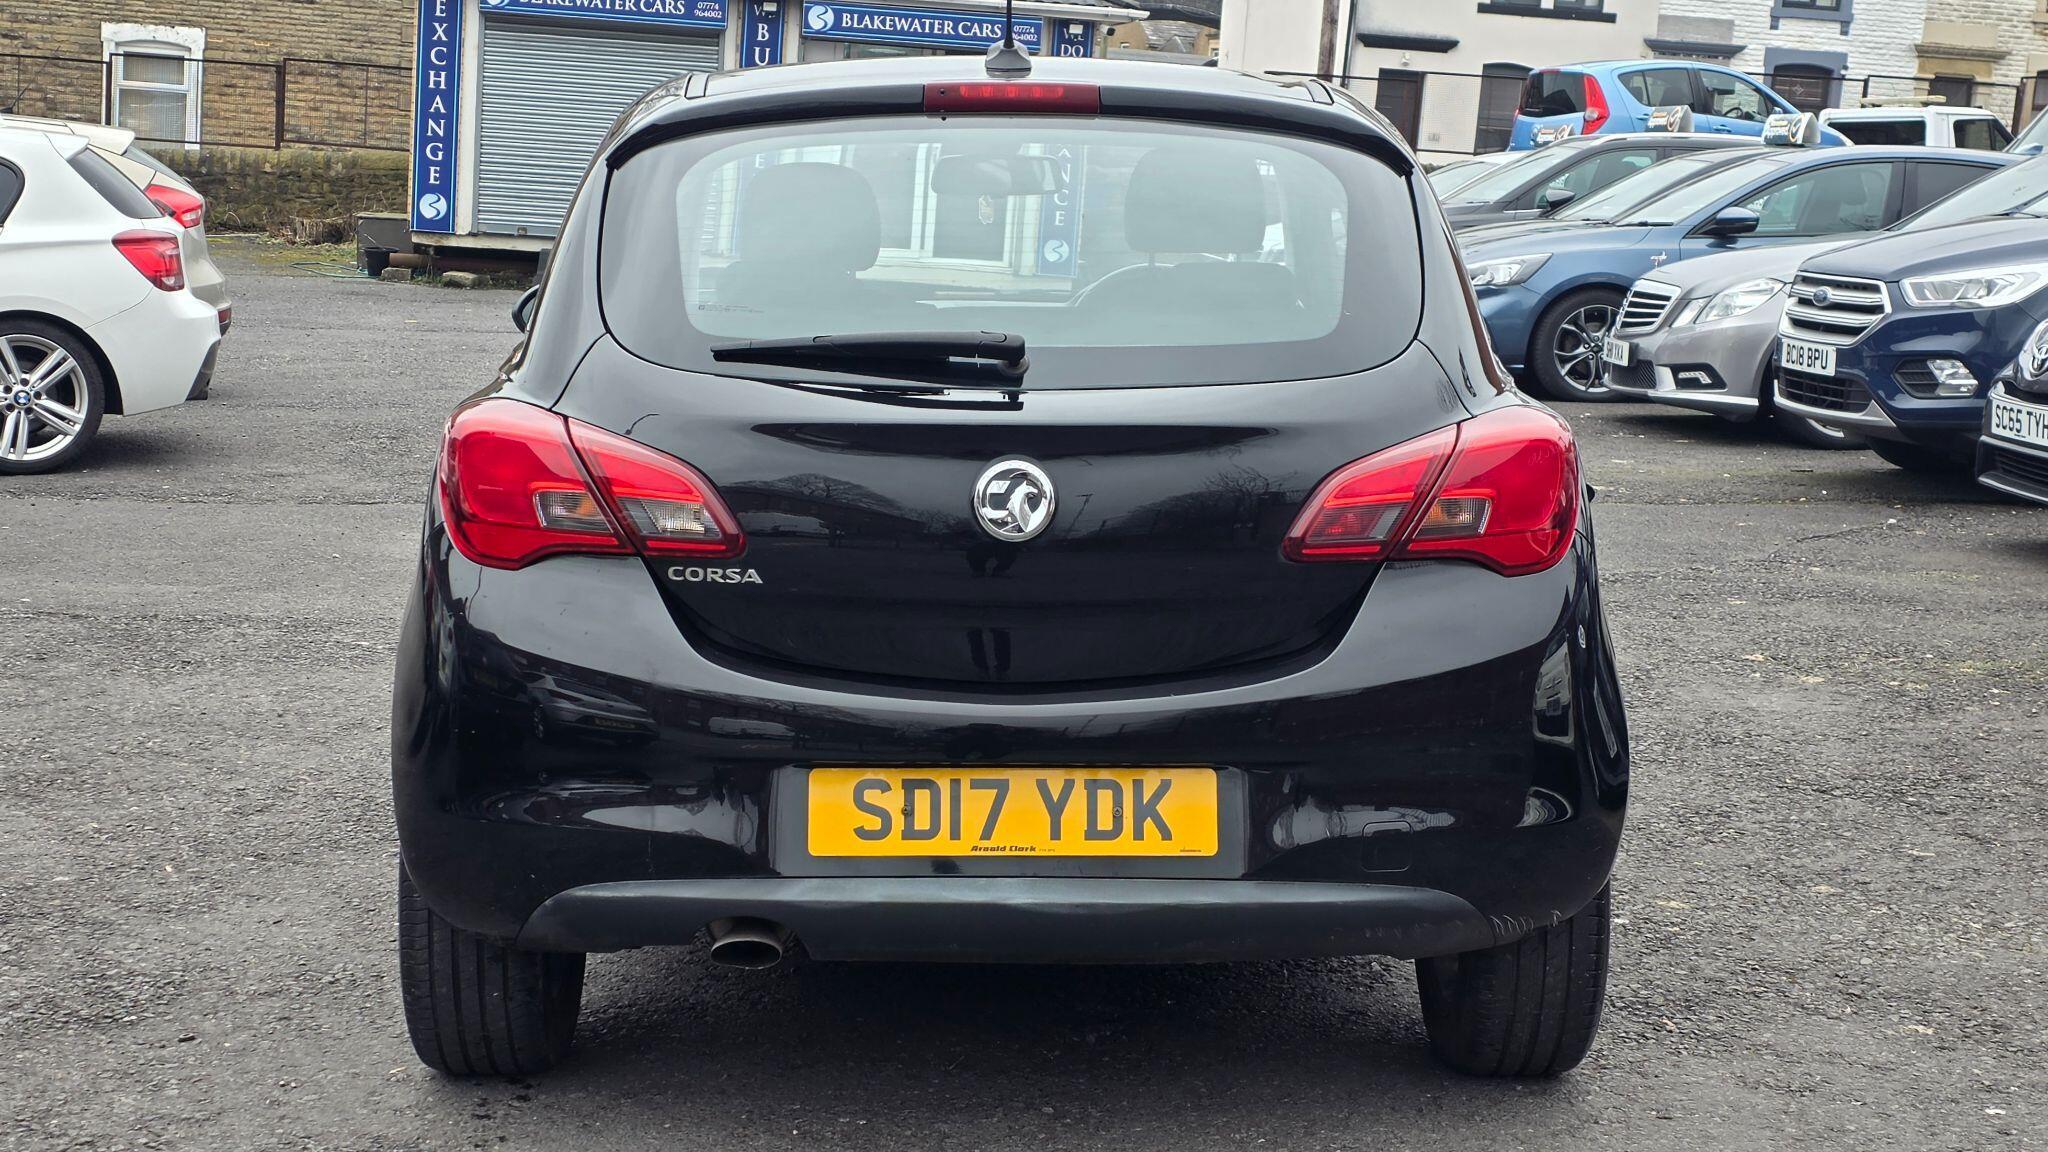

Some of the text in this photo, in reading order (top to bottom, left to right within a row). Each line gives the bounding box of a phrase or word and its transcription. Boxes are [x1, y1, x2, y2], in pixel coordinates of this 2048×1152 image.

[640, 1, 685, 15] CARS
[694, 9, 722, 18] 964002
[697, 1, 719, 10] 07774
[841, 13, 1002, 38] BLAKEWATER CARS
[1013, 25, 1034, 33] 07774
[1061, 44, 1083, 58] DO
[425, 0, 449, 185] EXCHANGE
[1786, 343, 1828, 370] BC18 BPU
[1995, 404, 2048, 439] SC65 TYH
[667, 566, 763, 584] CORSA
[852, 778, 1173, 841] SD17 YDK
